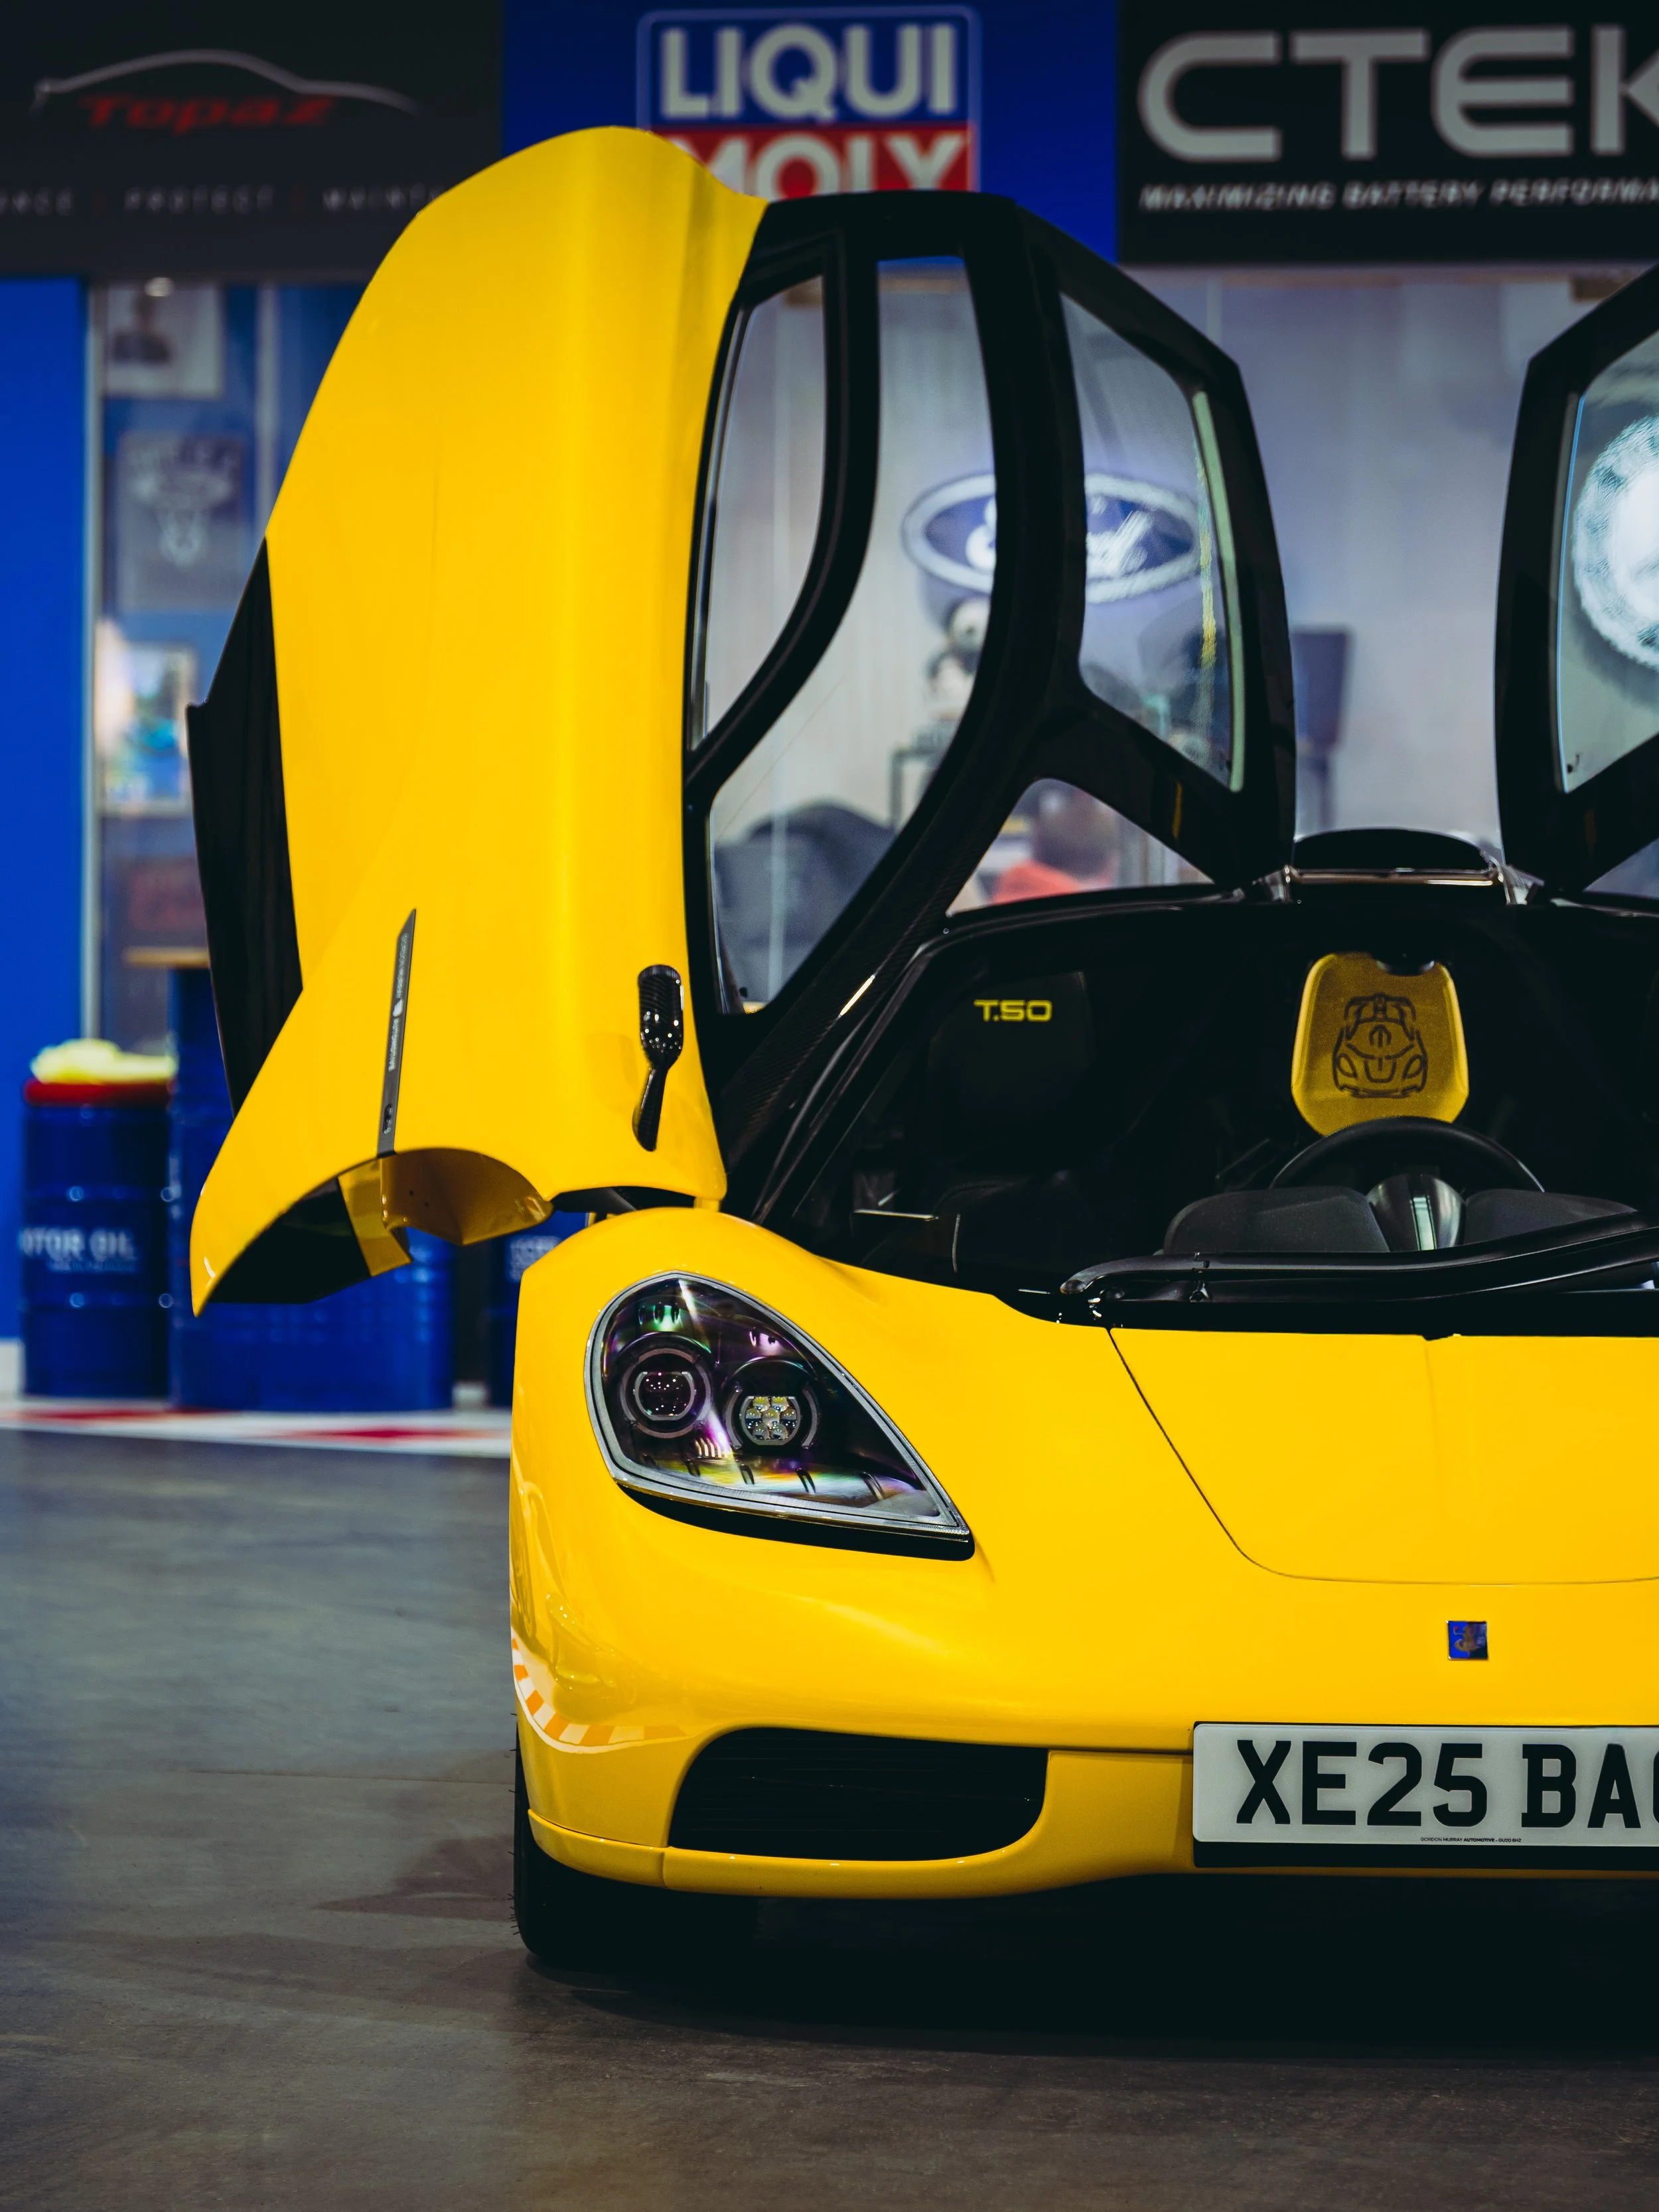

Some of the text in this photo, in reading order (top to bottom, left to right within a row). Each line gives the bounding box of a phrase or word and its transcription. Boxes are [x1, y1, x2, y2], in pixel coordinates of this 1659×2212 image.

[661, 24, 957, 122] LIQUI
[1342, 181, 1482, 209] BATTERY
[974, 999, 1052, 1021] T.50
[1236, 1739, 1659, 1829] XE25 BA
